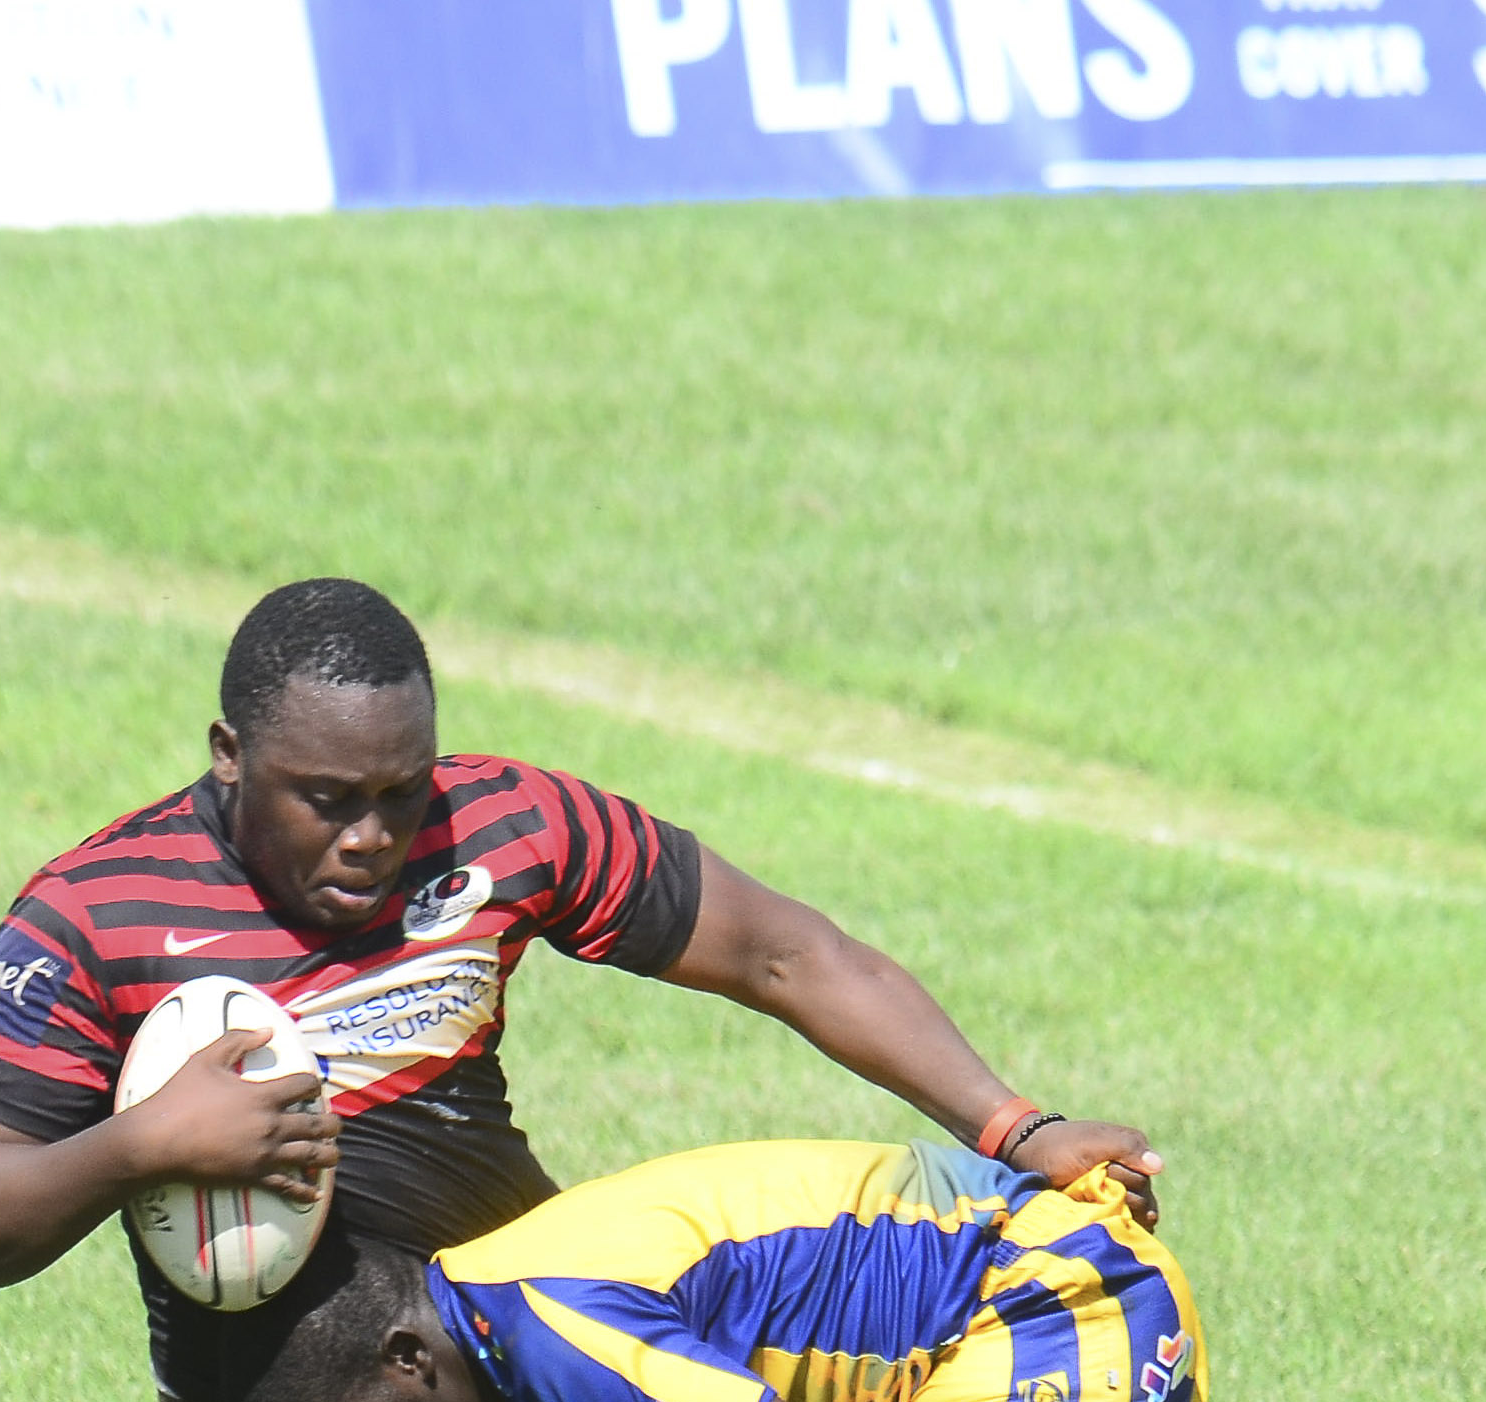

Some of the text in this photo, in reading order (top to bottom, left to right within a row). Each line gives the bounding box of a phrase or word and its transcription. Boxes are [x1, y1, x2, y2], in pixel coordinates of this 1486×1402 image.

[611, 0, 1195, 137] PLANS
[1235, 24, 1430, 100] COVER
[326, 958, 495, 1035] RESOLU
